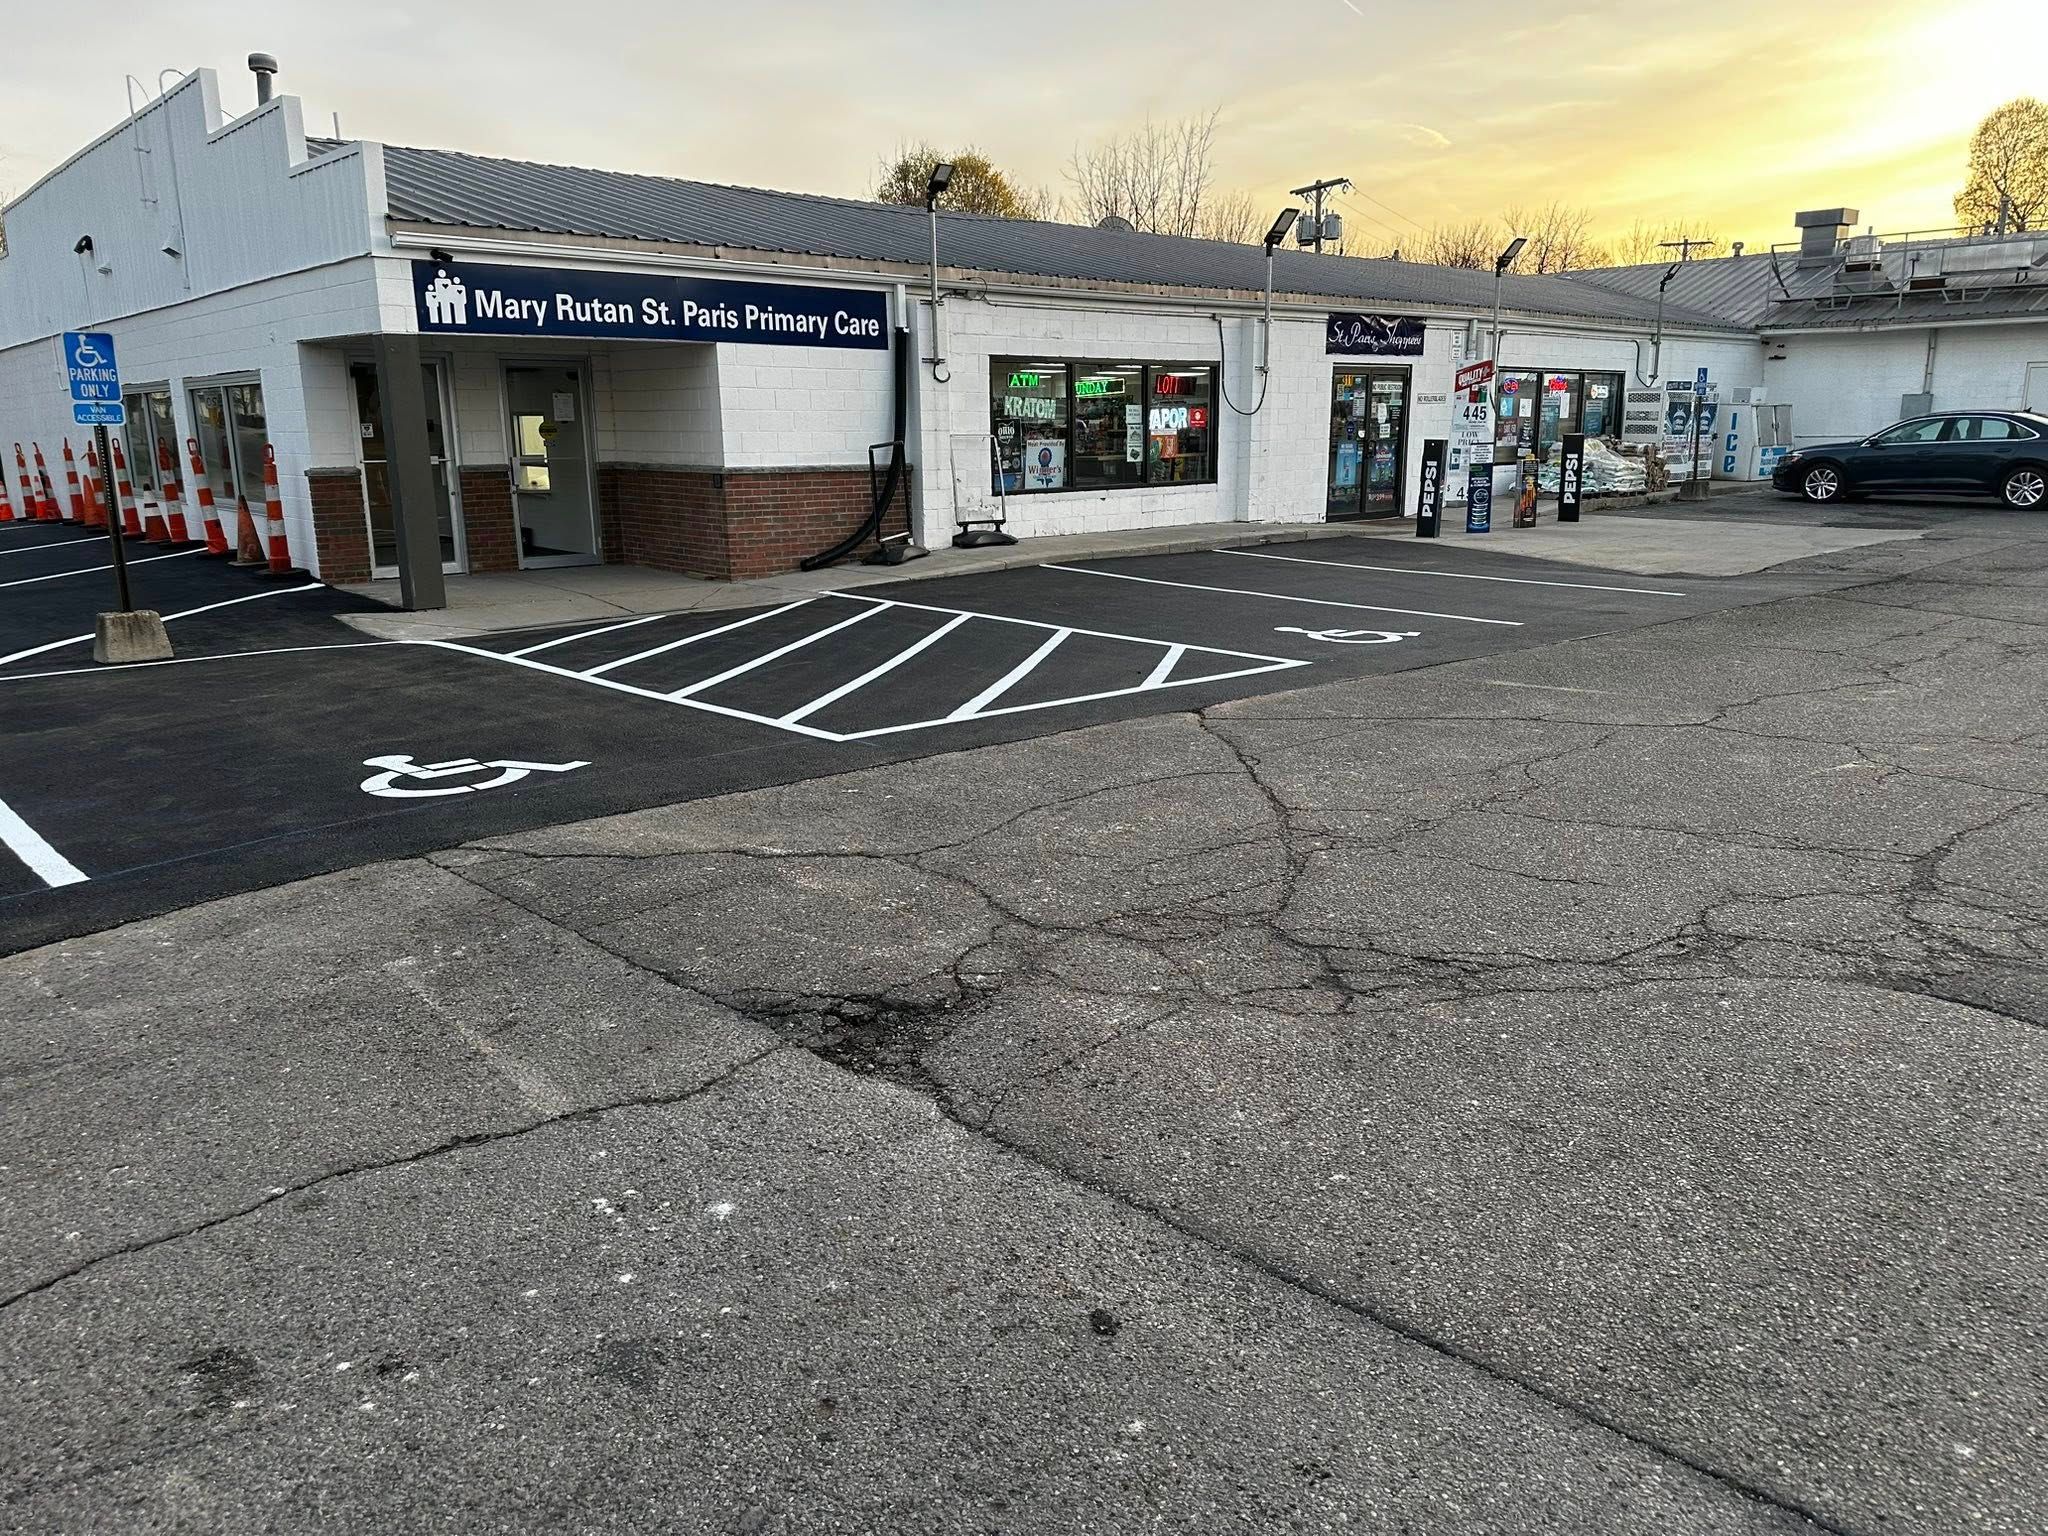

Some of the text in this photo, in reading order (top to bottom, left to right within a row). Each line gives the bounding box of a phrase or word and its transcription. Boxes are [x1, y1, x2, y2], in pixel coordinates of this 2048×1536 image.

[474, 289, 880, 339] Mary Rutan St. Paris Primary Care
[69, 367, 117, 382] PARKING
[1010, 374, 1039, 387] ATM
[1459, 367, 1484, 386] QUALITY
[80, 383, 110, 397] ONLY
[1076, 380, 1109, 394] UNDAY
[1003, 395, 1057, 420] KRATOM
[76, 414, 121, 422] ACCESSIBLE
[1148, 407, 1188, 430] APOR
[1028, 465, 1062, 475] Winner's
[1563, 453, 1579, 504] PEPSI
[1421, 460, 1438, 518] PEPSI
